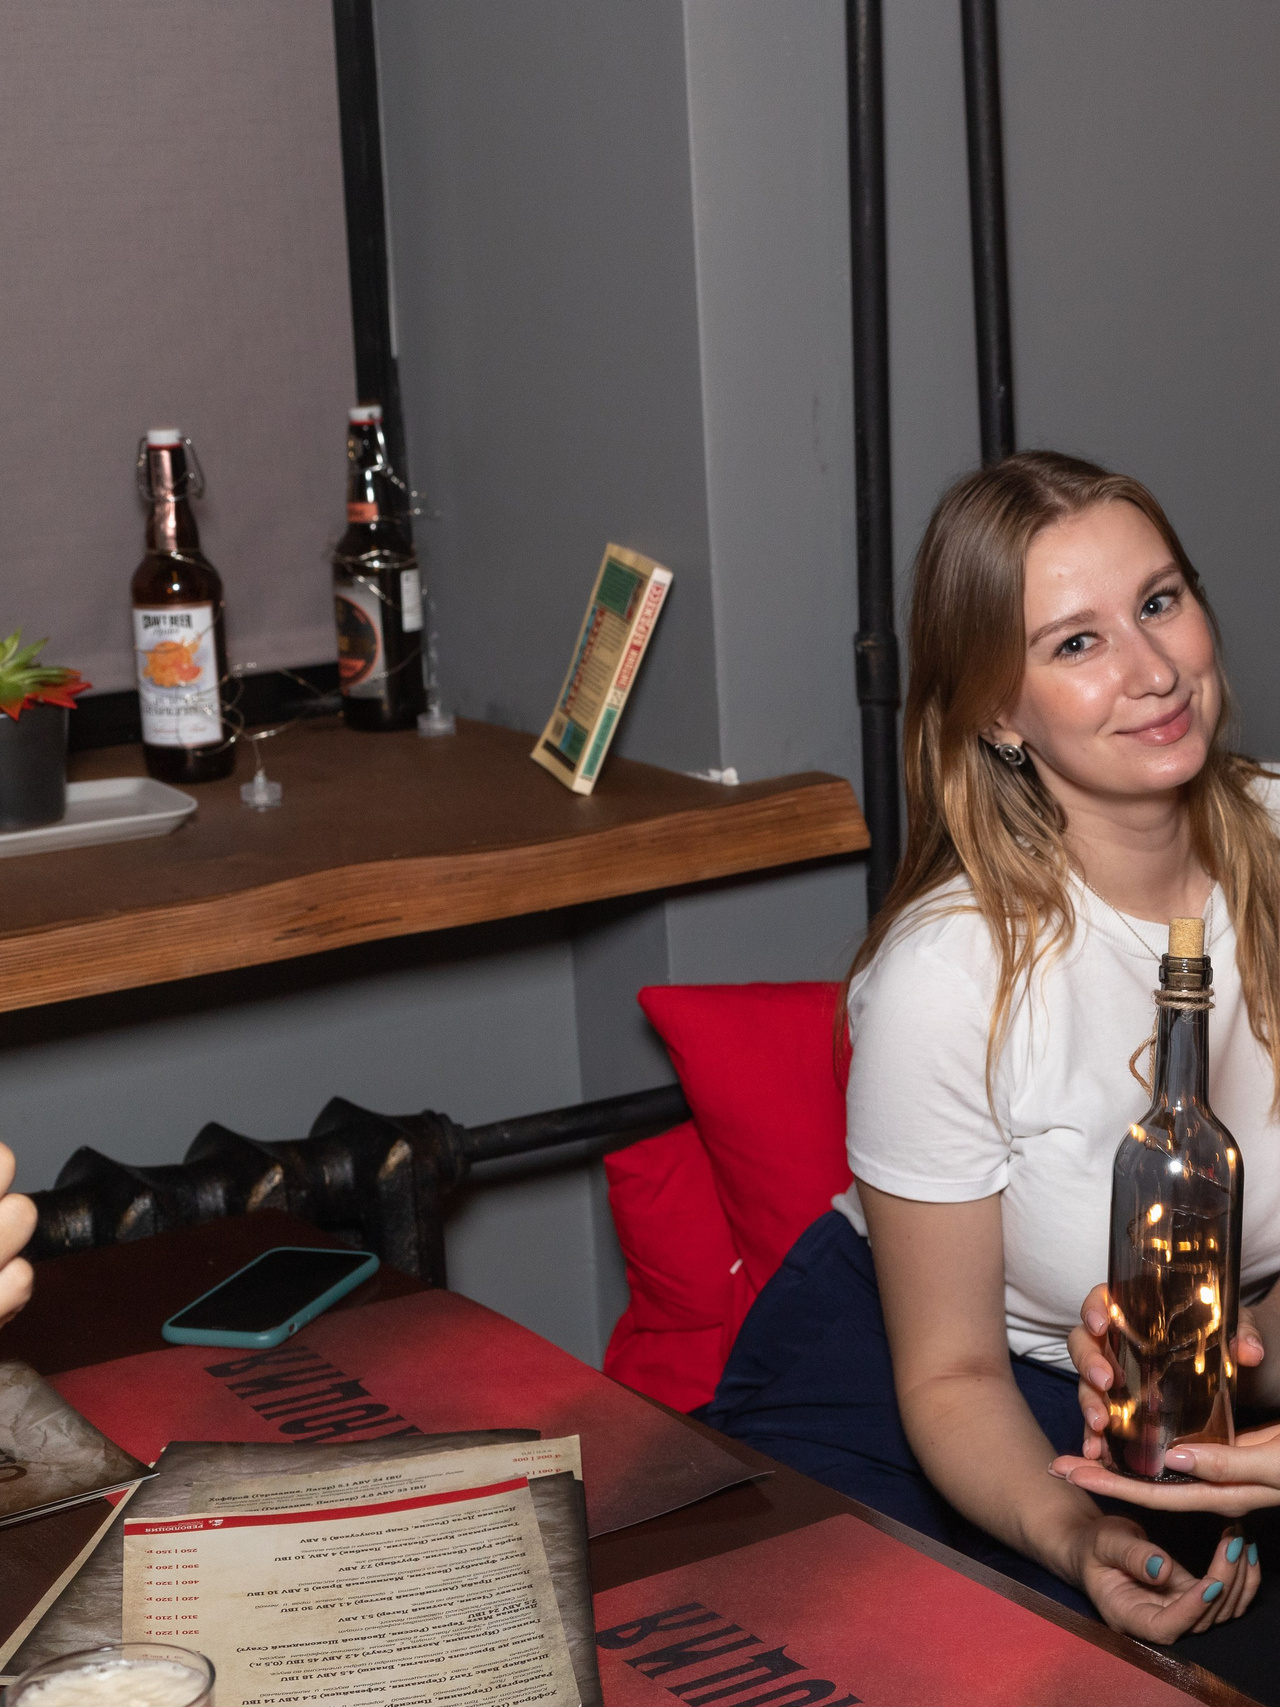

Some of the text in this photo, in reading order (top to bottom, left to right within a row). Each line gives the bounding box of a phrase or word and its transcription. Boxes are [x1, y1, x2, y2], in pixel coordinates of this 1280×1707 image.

[170, 613, 193, 629] BEER
[202, 1346, 424, 1444] ЮЦИЯ
[251, 1490, 303, 1499] (Германия,
[477, 1506, 516, 1518] Дальняя
[145, 1524, 203, 1533] РЕВОЛЮЦИЯ
[411, 1519, 450, 1529] (Россия,
[329, 1531, 383, 1541] Полусухой)
[495, 1536, 523, 1546] Барбе
[383, 1539, 429, 1549] (Бельгия,
[339, 1547, 381, 1556] Ламбик)
[422, 1548, 468, 1559] (Бельгия,
[374, 1557, 420, 1568] Фрутбир)
[407, 1567, 452, 1578] (Бельгия,
[495, 1569, 530, 1581] Лондон
[345, 1576, 404, 1587] Малиновый
[461, 1579, 492, 1588] Прайд
[395, 1585, 459, 1599] (Английский
[495, 1583, 533, 1596] Вельвет
[354, 1596, 393, 1605] Биттер)
[524, 1598, 537, 1606] 7.5
[411, 1601, 454, 1612] Азотный
[496, 1603, 537, 1617] Двойная
[502, 1602, 521, 1611] ABV
[376, 1609, 409, 1618] Лагер)
[467, 1615, 493, 1623] Мать
[468, 1611, 486, 1619] IBU
[389, 1626, 429, 1636] (Россия,
[432, 1621, 465, 1630] Тереза
[341, 1633, 386, 1643] Двойной
[442, 1629, 500, 1643] (Ирландия,
[512, 1634, 545, 1646] Бланш
[271, 1639, 338, 1650] Шоколадный
[396, 1641, 440, 1652] Азотный
[361, 1649, 394, 1657] Стаут)
[448, 1647, 495, 1659] Брюссель
[397, 1656, 446, 1667] (Бельгия,
[502, 1653, 549, 1668] Шнайдер
[357, 1665, 395, 1674] Бланш)
[475, 1666, 499, 1675] Вайс
[389, 1676, 447, 1689] (Германия,
[495, 1671, 553, 1689] Радебергер
[435, 1686, 493, 1701] (Германия,
[512, 1689, 557, 1705] Хофброй
